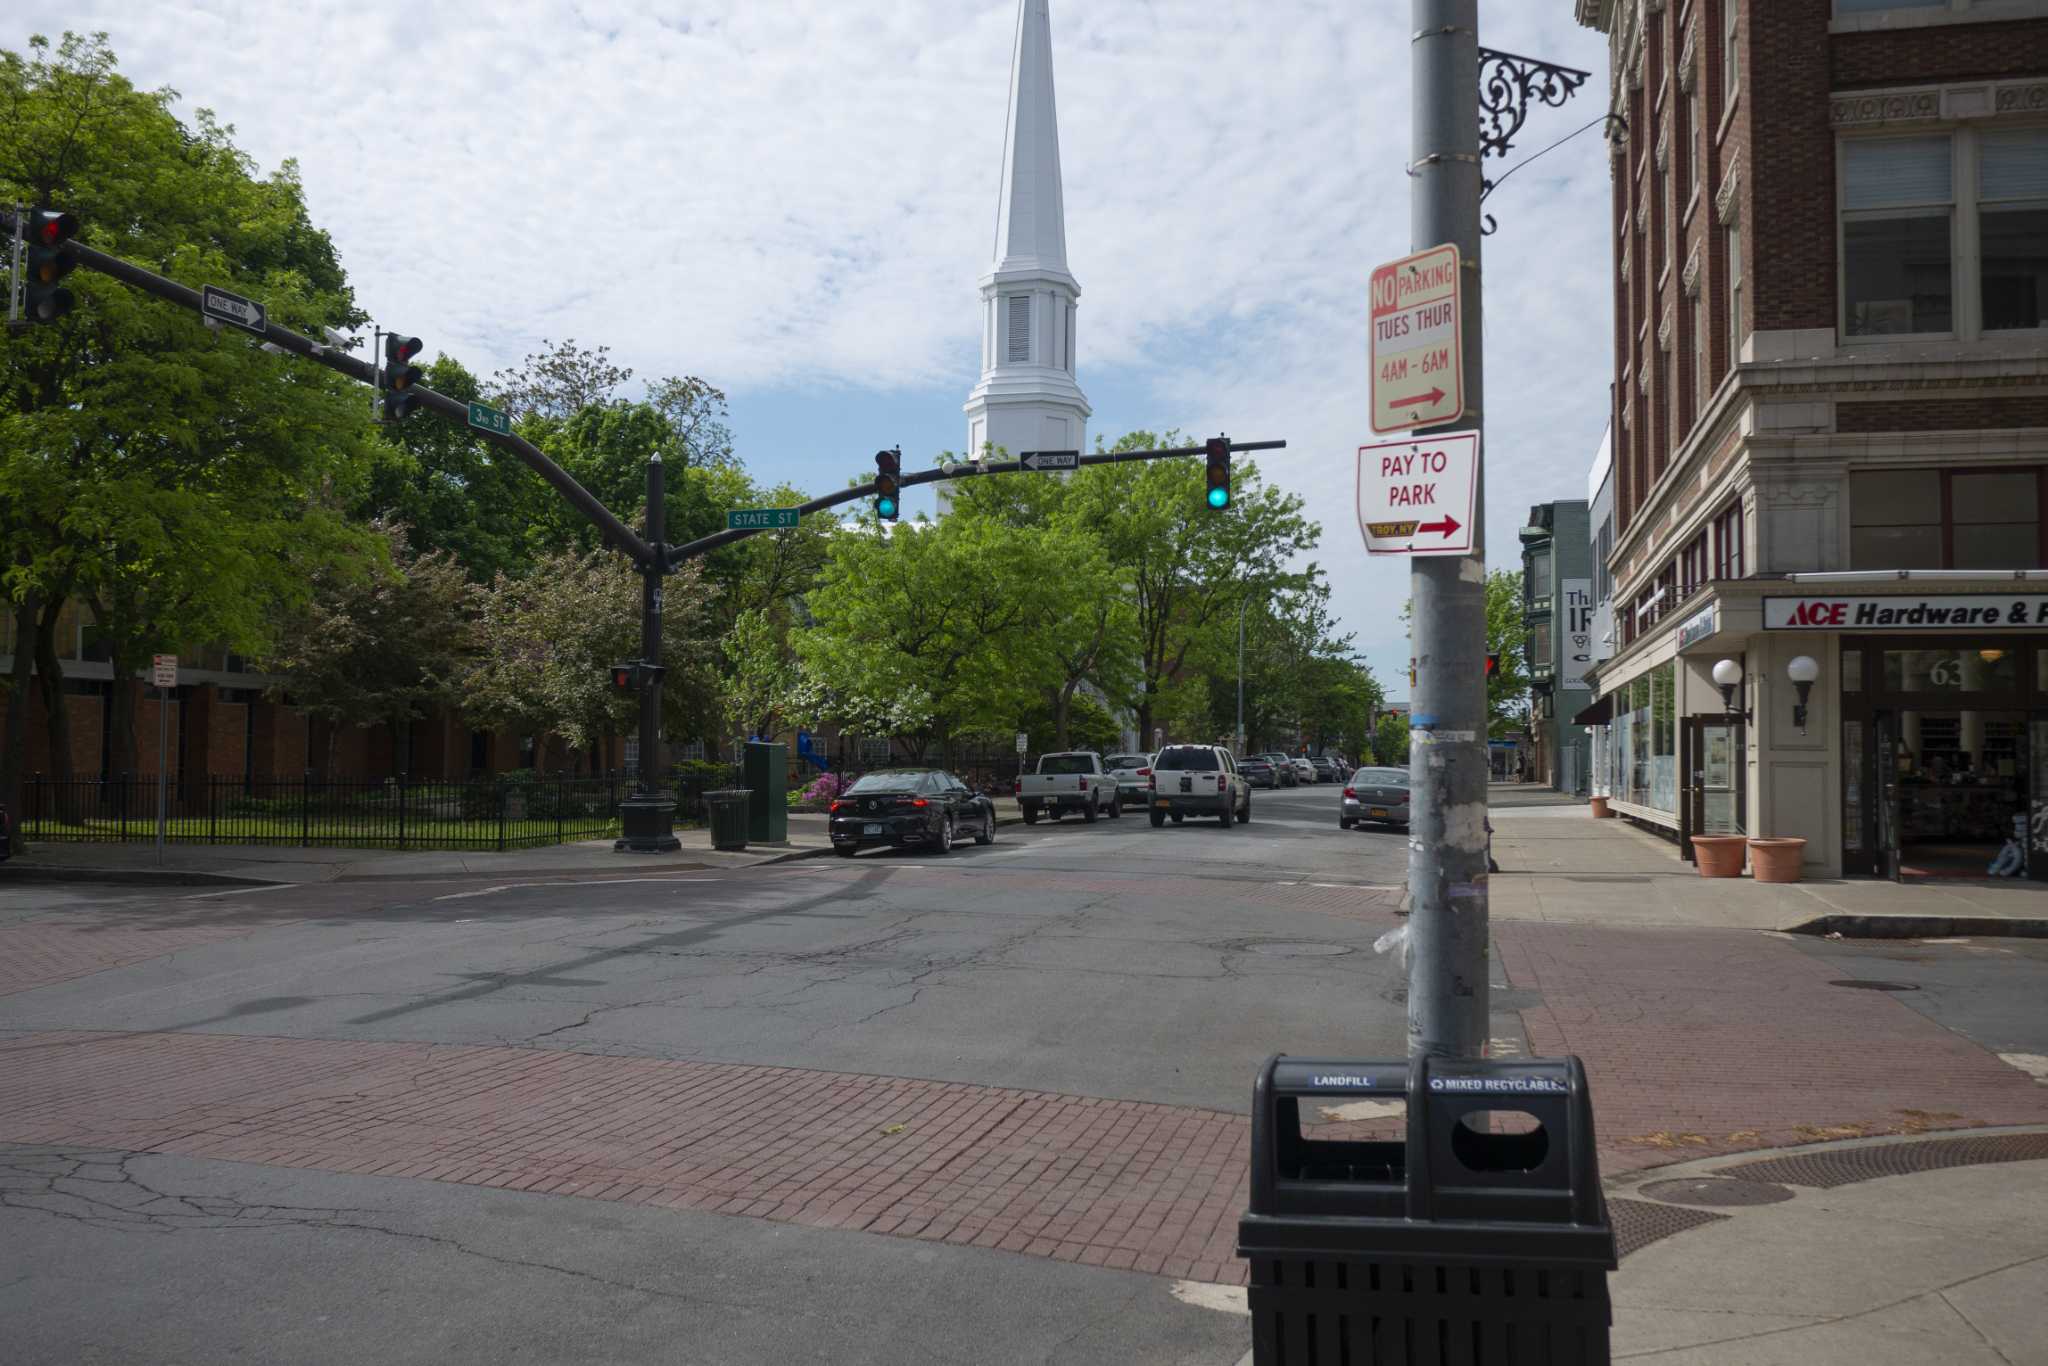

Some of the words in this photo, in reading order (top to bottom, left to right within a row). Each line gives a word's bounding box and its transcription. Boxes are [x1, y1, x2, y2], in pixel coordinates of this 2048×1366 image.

[1372, 274, 1396, 310] NO
[1400, 262, 1453, 297] PARKING
[209, 295, 230, 311] ONE
[231, 302, 248, 316] WAY
[1377, 314, 1409, 341] TUES
[1416, 302, 1452, 331] THUR
[1381, 357, 1408, 383] 4AM
[1422, 347, 1449, 375] 6AM
[493, 414, 505, 430] ST
[1039, 455, 1055, 465] ONE
[1056, 455, 1073, 465] WAY
[1381, 454, 1415, 477] PAY
[1420, 451, 1447, 474] TO
[1389, 483, 1436, 507] PARK
[735, 513, 769, 526] STATE
[778, 512, 793, 524] ST
[1785, 600, 1849, 626] ACE
[1854, 602, 2000, 625] Hardware
[2007, 601, 2029, 625] &
[1930, 658, 1964, 686] 63
[1314, 1076, 1371, 1087] LANDFILL
[1445, 1079, 1482, 1090] MIXED
